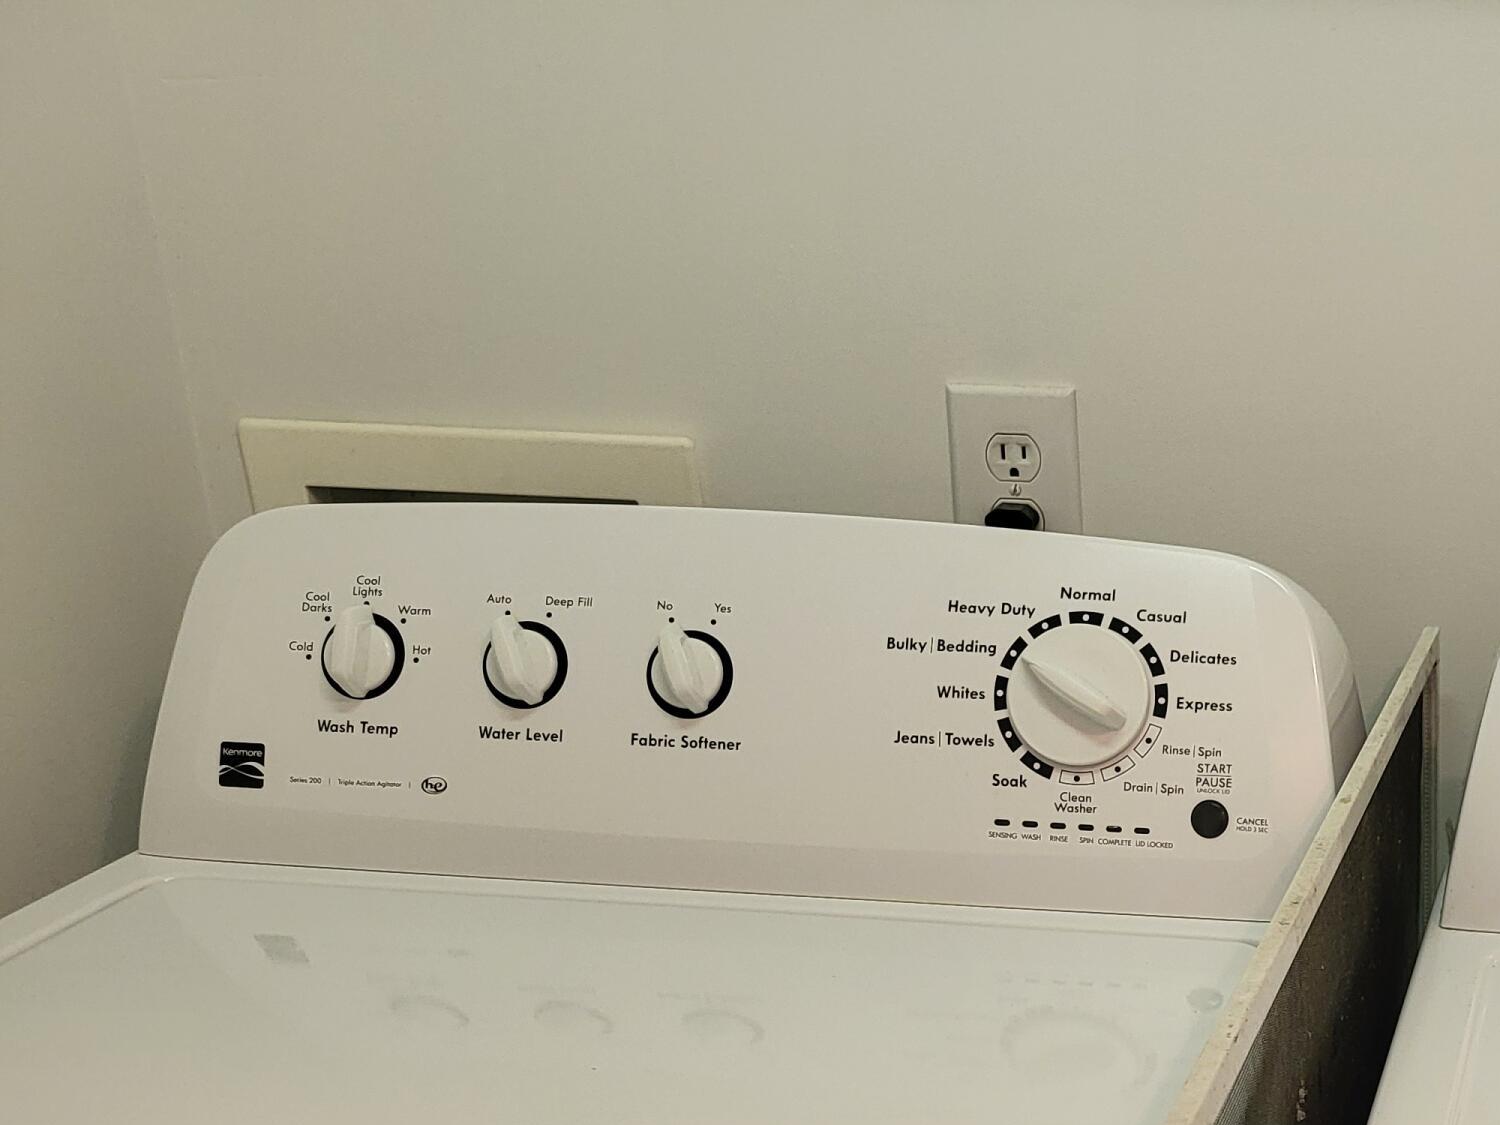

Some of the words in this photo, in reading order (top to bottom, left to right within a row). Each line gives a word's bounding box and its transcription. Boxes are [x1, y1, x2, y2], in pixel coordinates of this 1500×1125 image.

[357, 575, 380, 585] Cool
[305, 592, 329, 603] Cool
[353, 586, 382, 598] Lights
[1061, 587, 1115, 601] Normal
[487, 594, 511, 604] Auto
[546, 596, 573, 608] Deep
[578, 597, 592, 606] Fill
[302, 602, 332, 612] Darks
[398, 605, 431, 615] Warm
[657, 601, 673, 610] No
[715, 603, 731, 613] Yes
[948, 600, 995, 616] Heavy
[1001, 603, 1035, 618] Duty
[1137, 609, 1186, 623] Casual
[289, 641, 313, 651] Cold
[413, 645, 431, 655] Hot
[887, 637, 927, 653] Bulky
[937, 639, 996, 656] Bedding
[1170, 650, 1236, 665] Delicates
[937, 686, 985, 699] Whites
[1177, 697, 1232, 713] Express
[318, 720, 354, 733] Wash
[360, 721, 398, 738] Temp
[479, 726, 520, 740] Water
[526, 728, 563, 742] Level
[631, 733, 675, 747] Fabric
[681, 736, 741, 750] Softener
[894, 731, 934, 744] Jeans
[945, 733, 994, 747] Towels
[223, 748, 262, 757] Kenmore
[1162, 745, 1190, 755] Rinse
[1198, 747, 1221, 759] Spin
[1197, 763, 1232, 774] START
[338, 778, 354, 786] Triple
[992, 774, 1027, 788] Soak
[1196, 777, 1232, 789] PAUSE
[1124, 782, 1152, 792] Drain
[1161, 784, 1184, 796] Spin
[1060, 792, 1091, 804] Clean
[1055, 802, 1097, 813] Washer
[1236, 817, 1268, 828] CANCEL
[988, 831, 1017, 839] SENSING
[1098, 838, 1131, 846] COMPLETE
